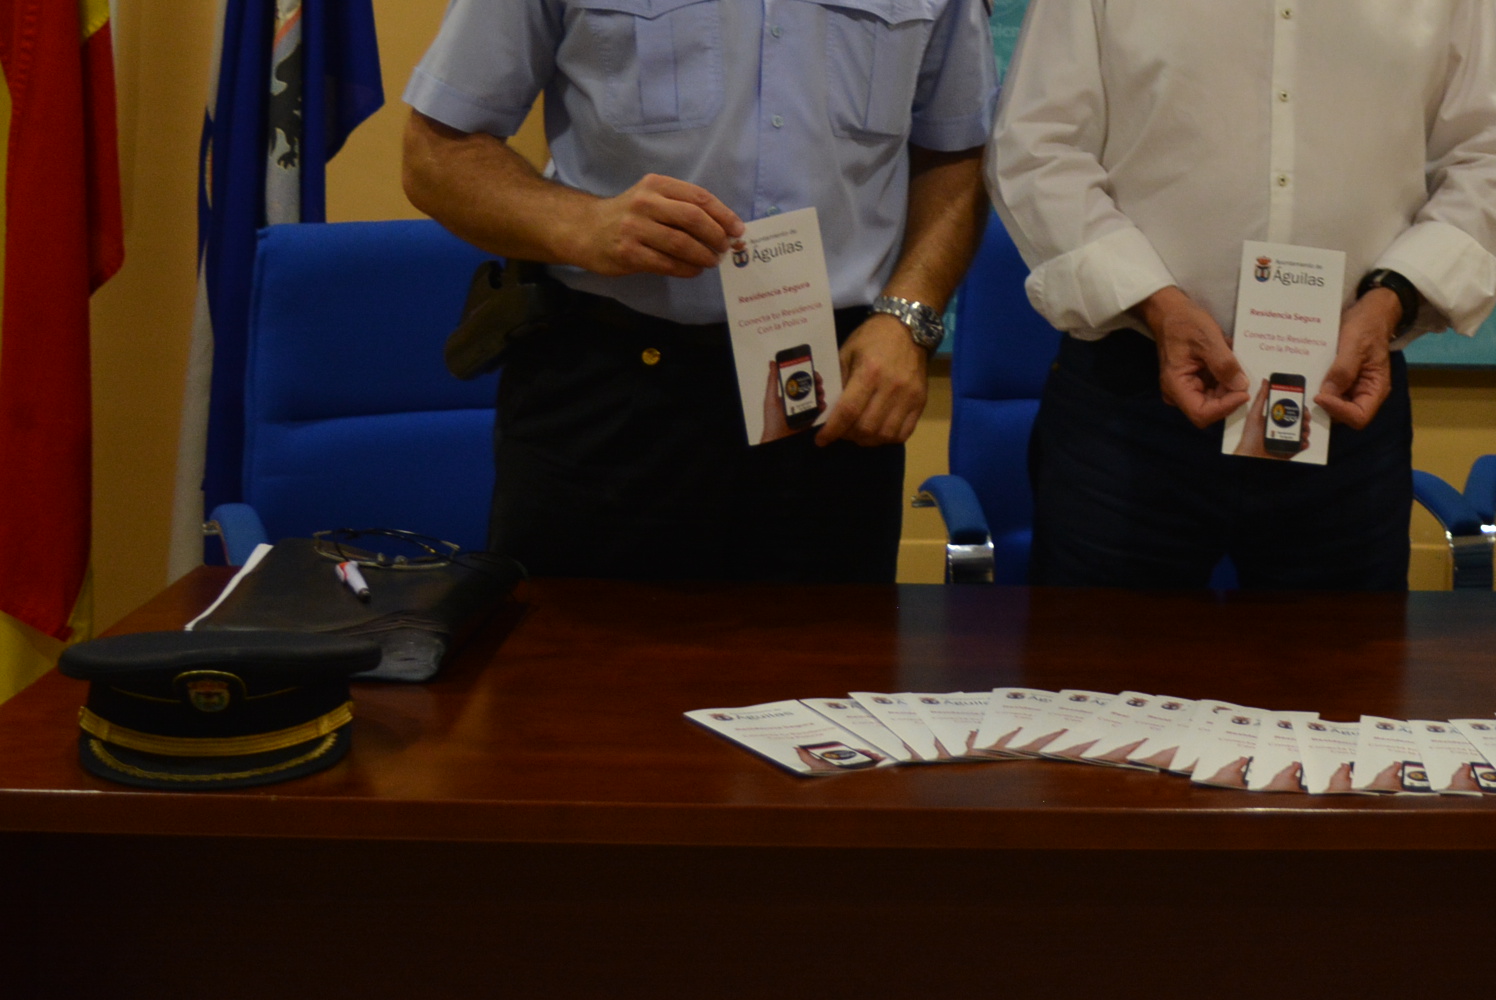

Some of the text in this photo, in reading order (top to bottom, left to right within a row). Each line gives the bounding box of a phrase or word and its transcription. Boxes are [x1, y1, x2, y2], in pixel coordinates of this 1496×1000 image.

[752, 241, 804, 263] Águilas
[1273, 265, 1325, 287] Águilas
[738, 282, 810, 303] Residencia Segura
[738, 314, 771, 328] Conecta
[781, 302, 822, 316] Residencia
[1250, 308, 1321, 323] Residencia Segura
[1243, 330, 1276, 341] Conecta
[1286, 335, 1328, 347] Residencia
